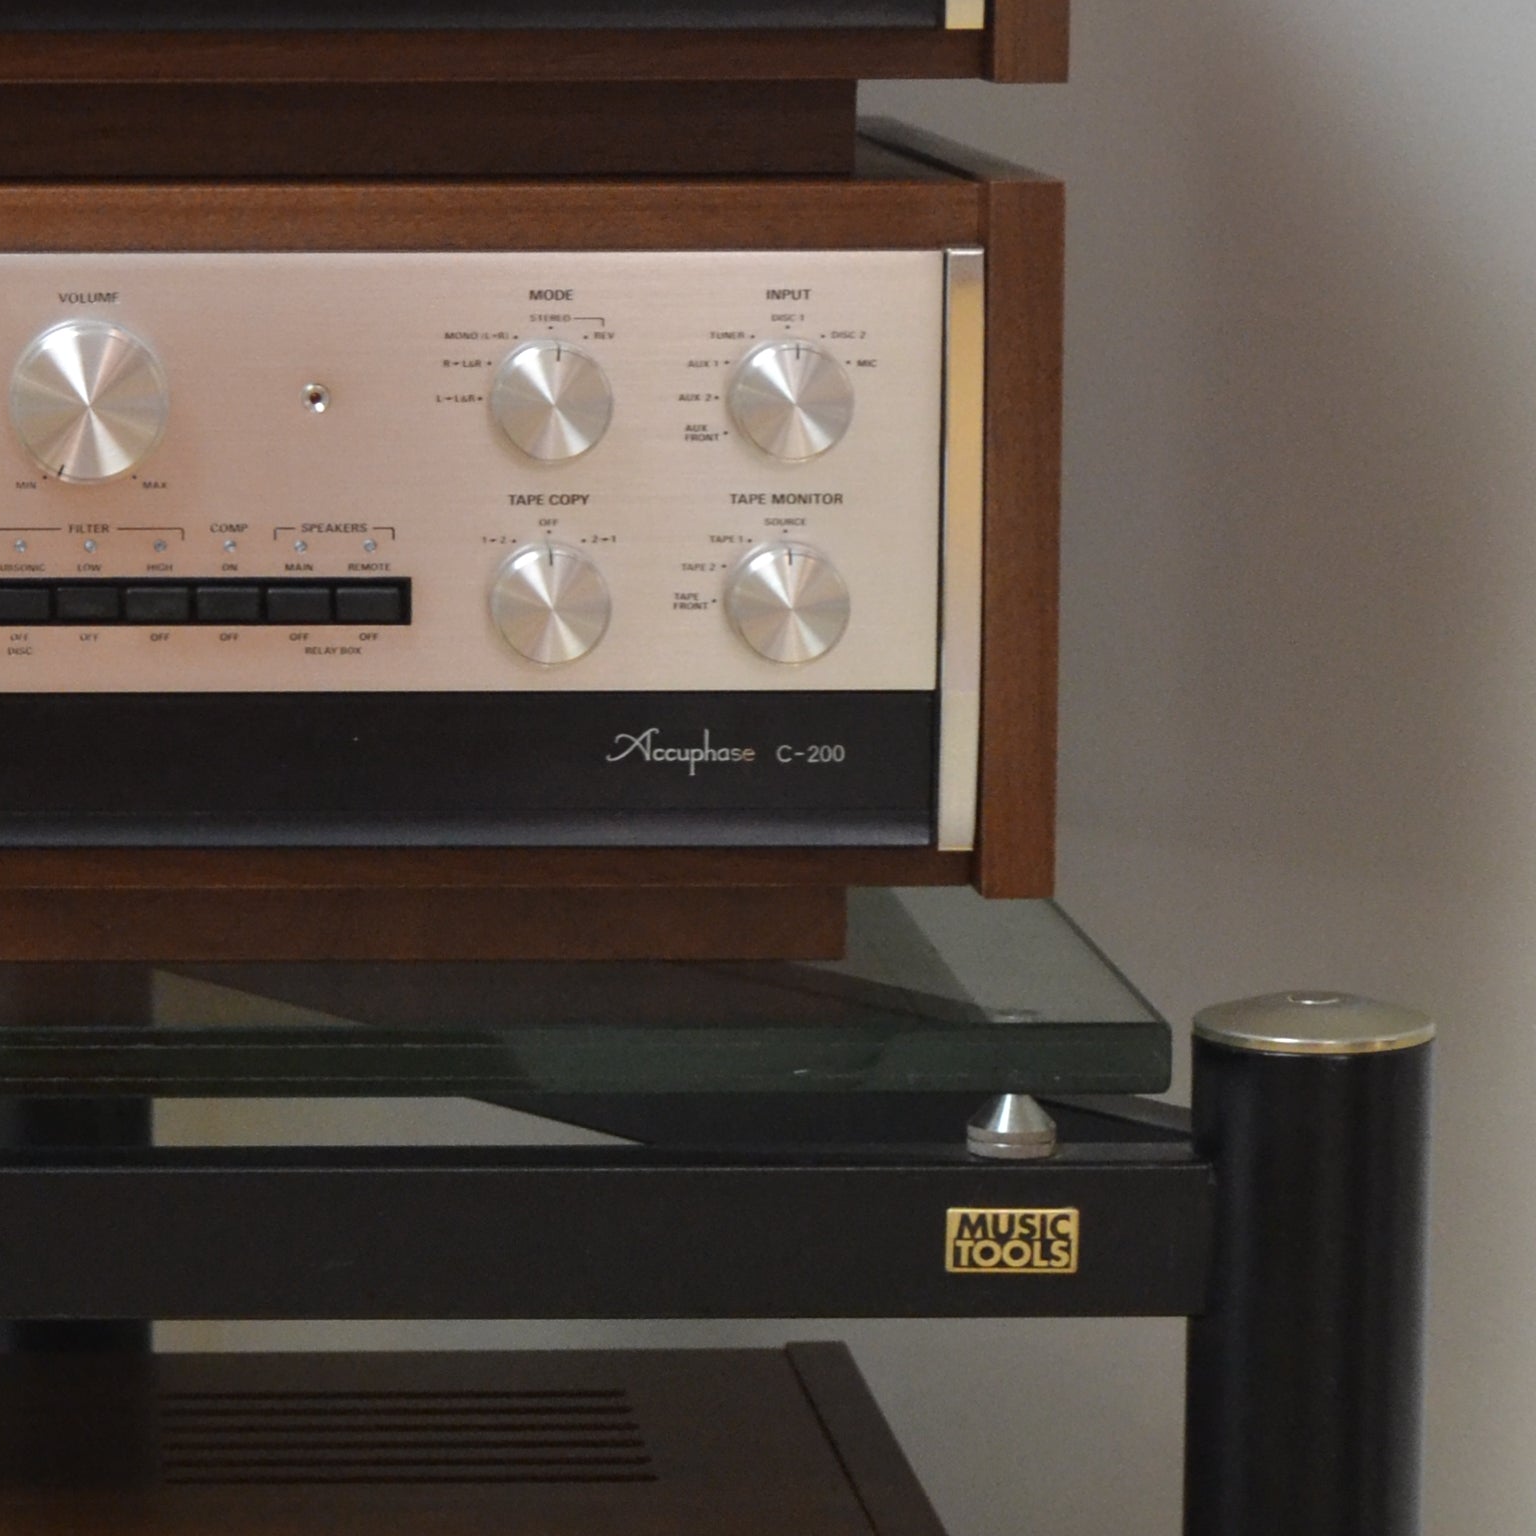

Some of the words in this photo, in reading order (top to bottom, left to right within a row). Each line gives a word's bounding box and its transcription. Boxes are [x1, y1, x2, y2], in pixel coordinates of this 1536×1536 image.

[59, 292, 119, 303] VOLUME
[529, 289, 574, 300] MODE
[766, 289, 811, 300] INPUT
[685, 424, 707, 432] AUX
[16, 481, 36, 489] MIN
[509, 494, 543, 505] TAPE
[549, 494, 590, 505] COPY
[730, 494, 766, 504] TAPE
[772, 494, 843, 504] MONITOR
[68, 524, 110, 534] FILTER
[210, 523, 248, 533] COMP
[302, 523, 367, 533] SPEAKERS
[147, 564, 172, 572] HIGH
[222, 563, 238, 571] ON
[285, 563, 312, 571] MAIN
[348, 563, 390, 571] REMOTE
[675, 593, 699, 601] TAPE
[673, 602, 708, 610] FRONT
[150, 633, 170, 641] OFF
[220, 633, 238, 641] OFF
[290, 633, 309, 641] OFF
[359, 633, 378, 641] OFF
[305, 647, 336, 655] RELAY
[340, 647, 361, 655] BOX
[606, 728, 756, 776] Accuphase
[776, 745, 845, 763] C-200
[957, 1214, 1070, 1239] MUSIC
[956, 1240, 1070, 1266] TOOLS
